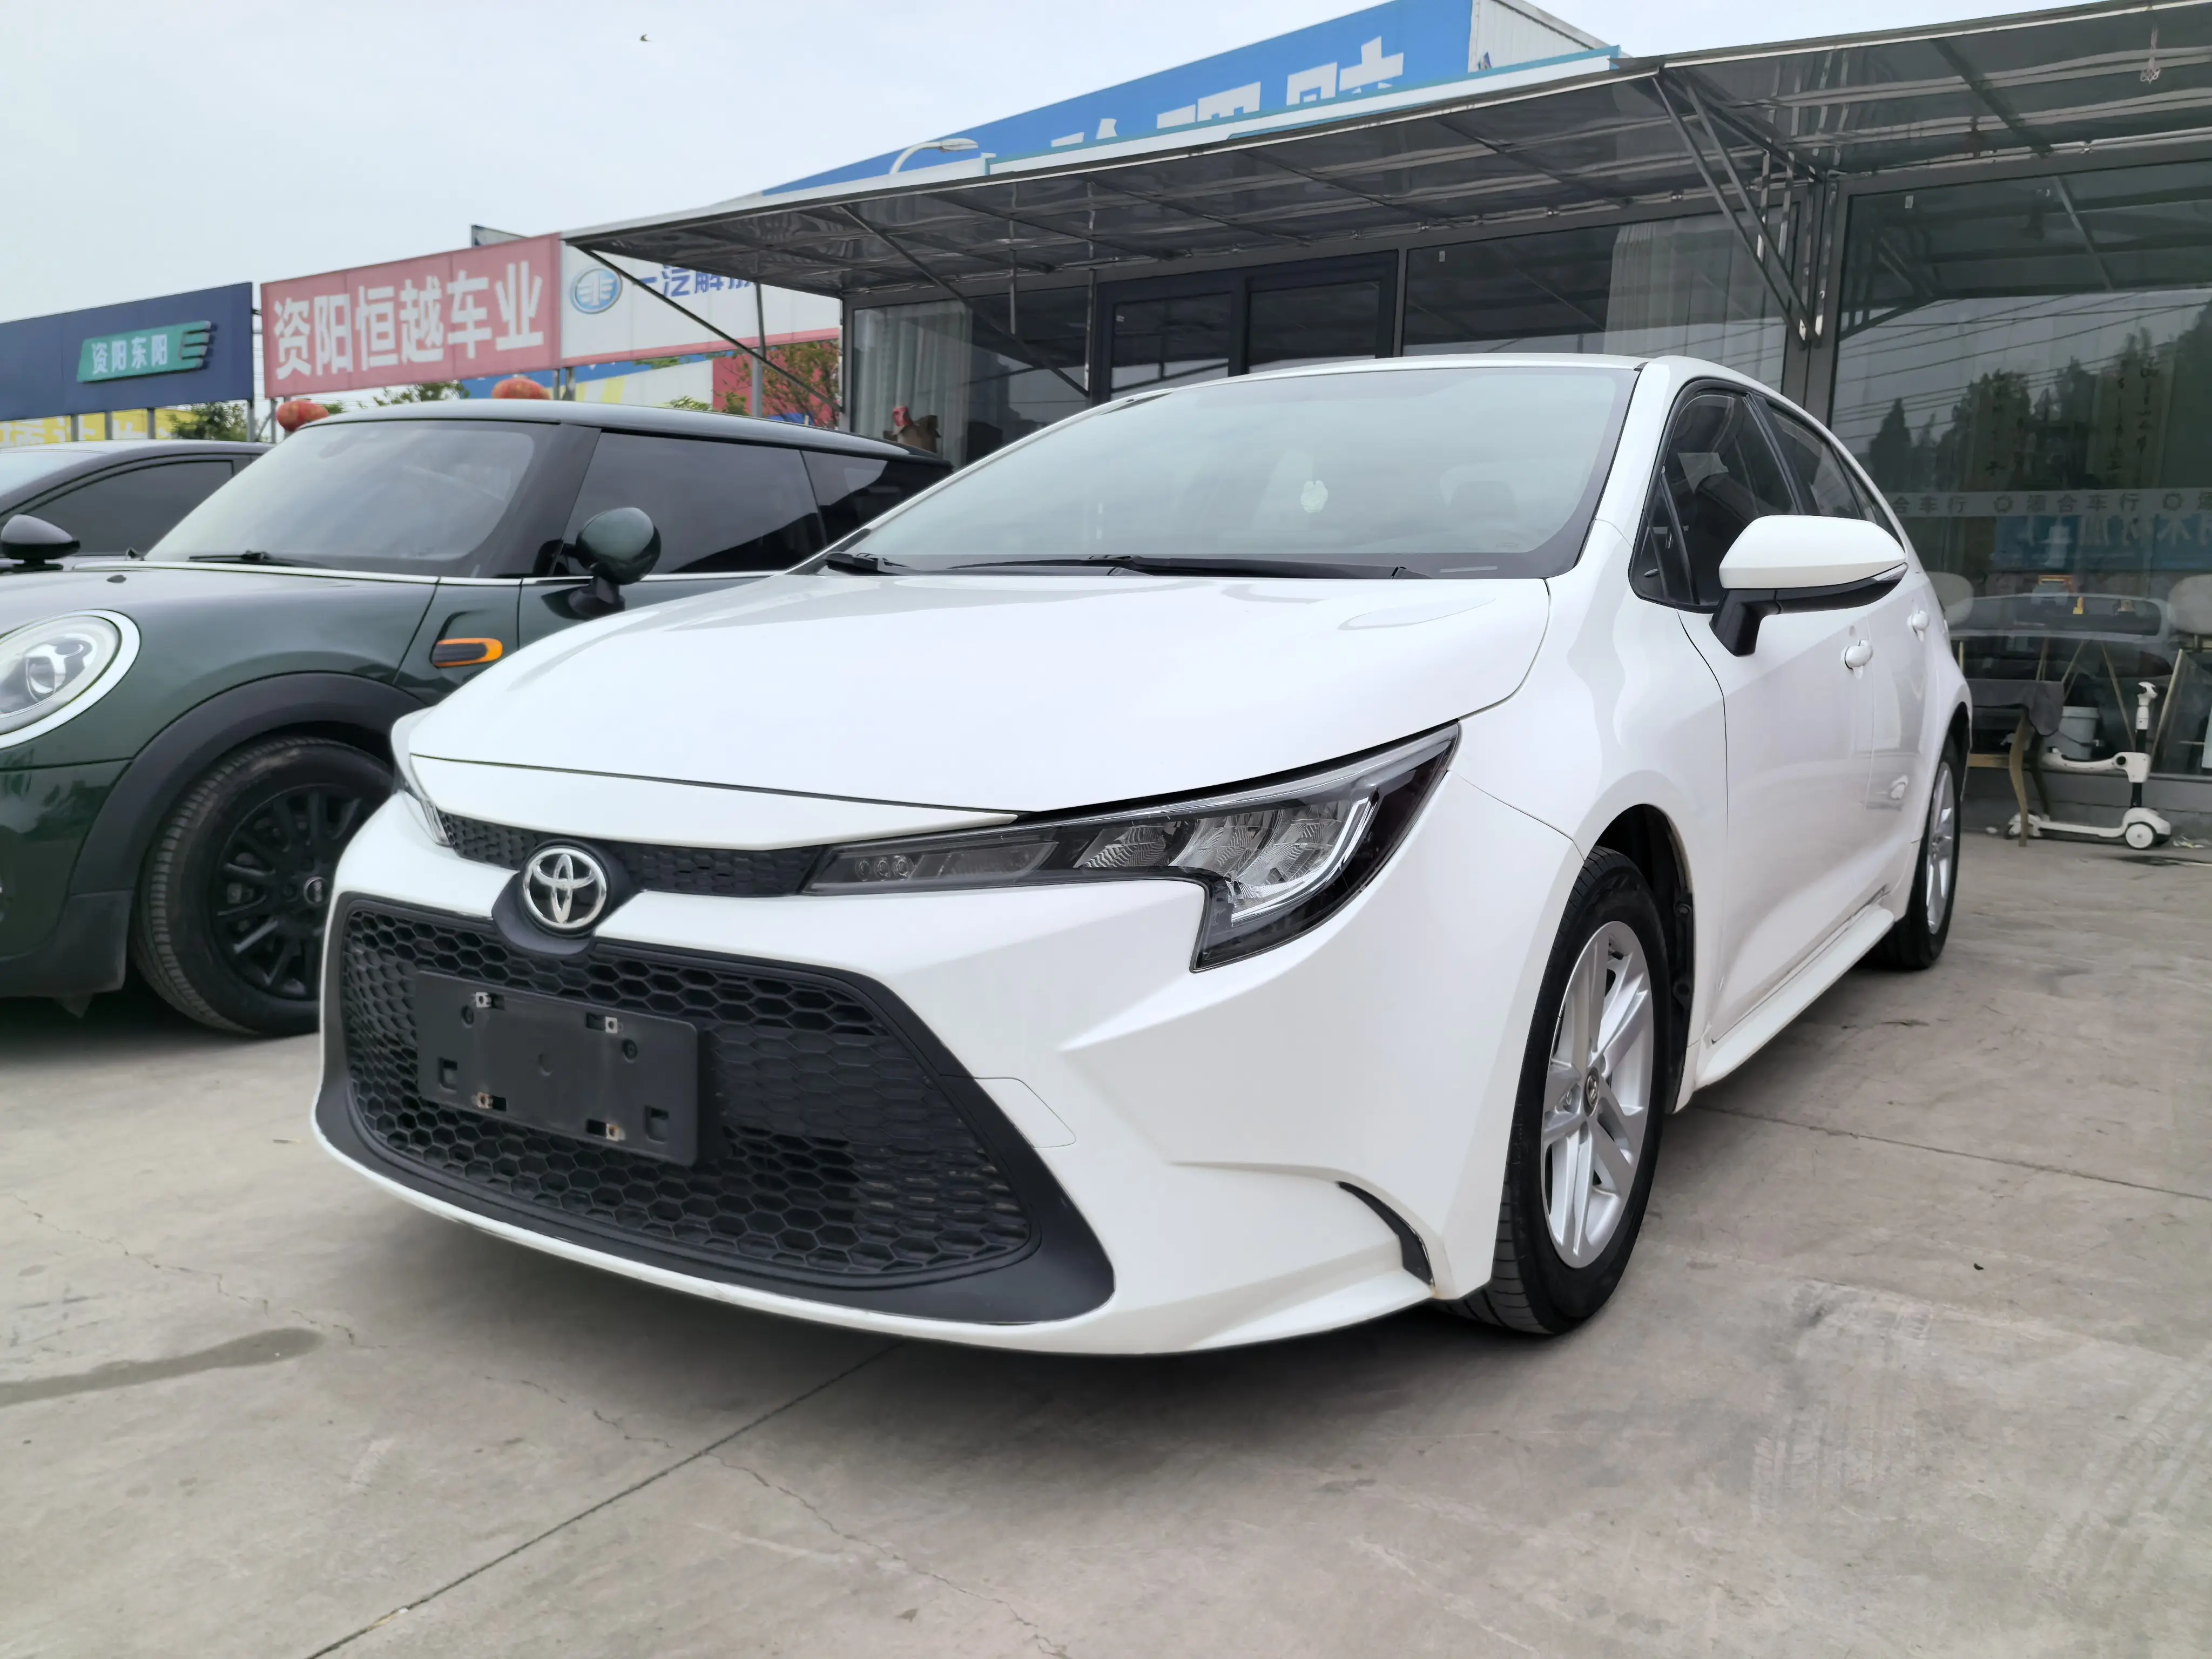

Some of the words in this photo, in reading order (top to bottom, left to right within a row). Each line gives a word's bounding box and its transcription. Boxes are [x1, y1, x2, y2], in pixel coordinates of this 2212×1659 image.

[274, 261, 544, 380] 资阳恒越车业
[91, 333, 168, 374] 资阳东阳
[2026, 492, 2140, 513] 合车行
